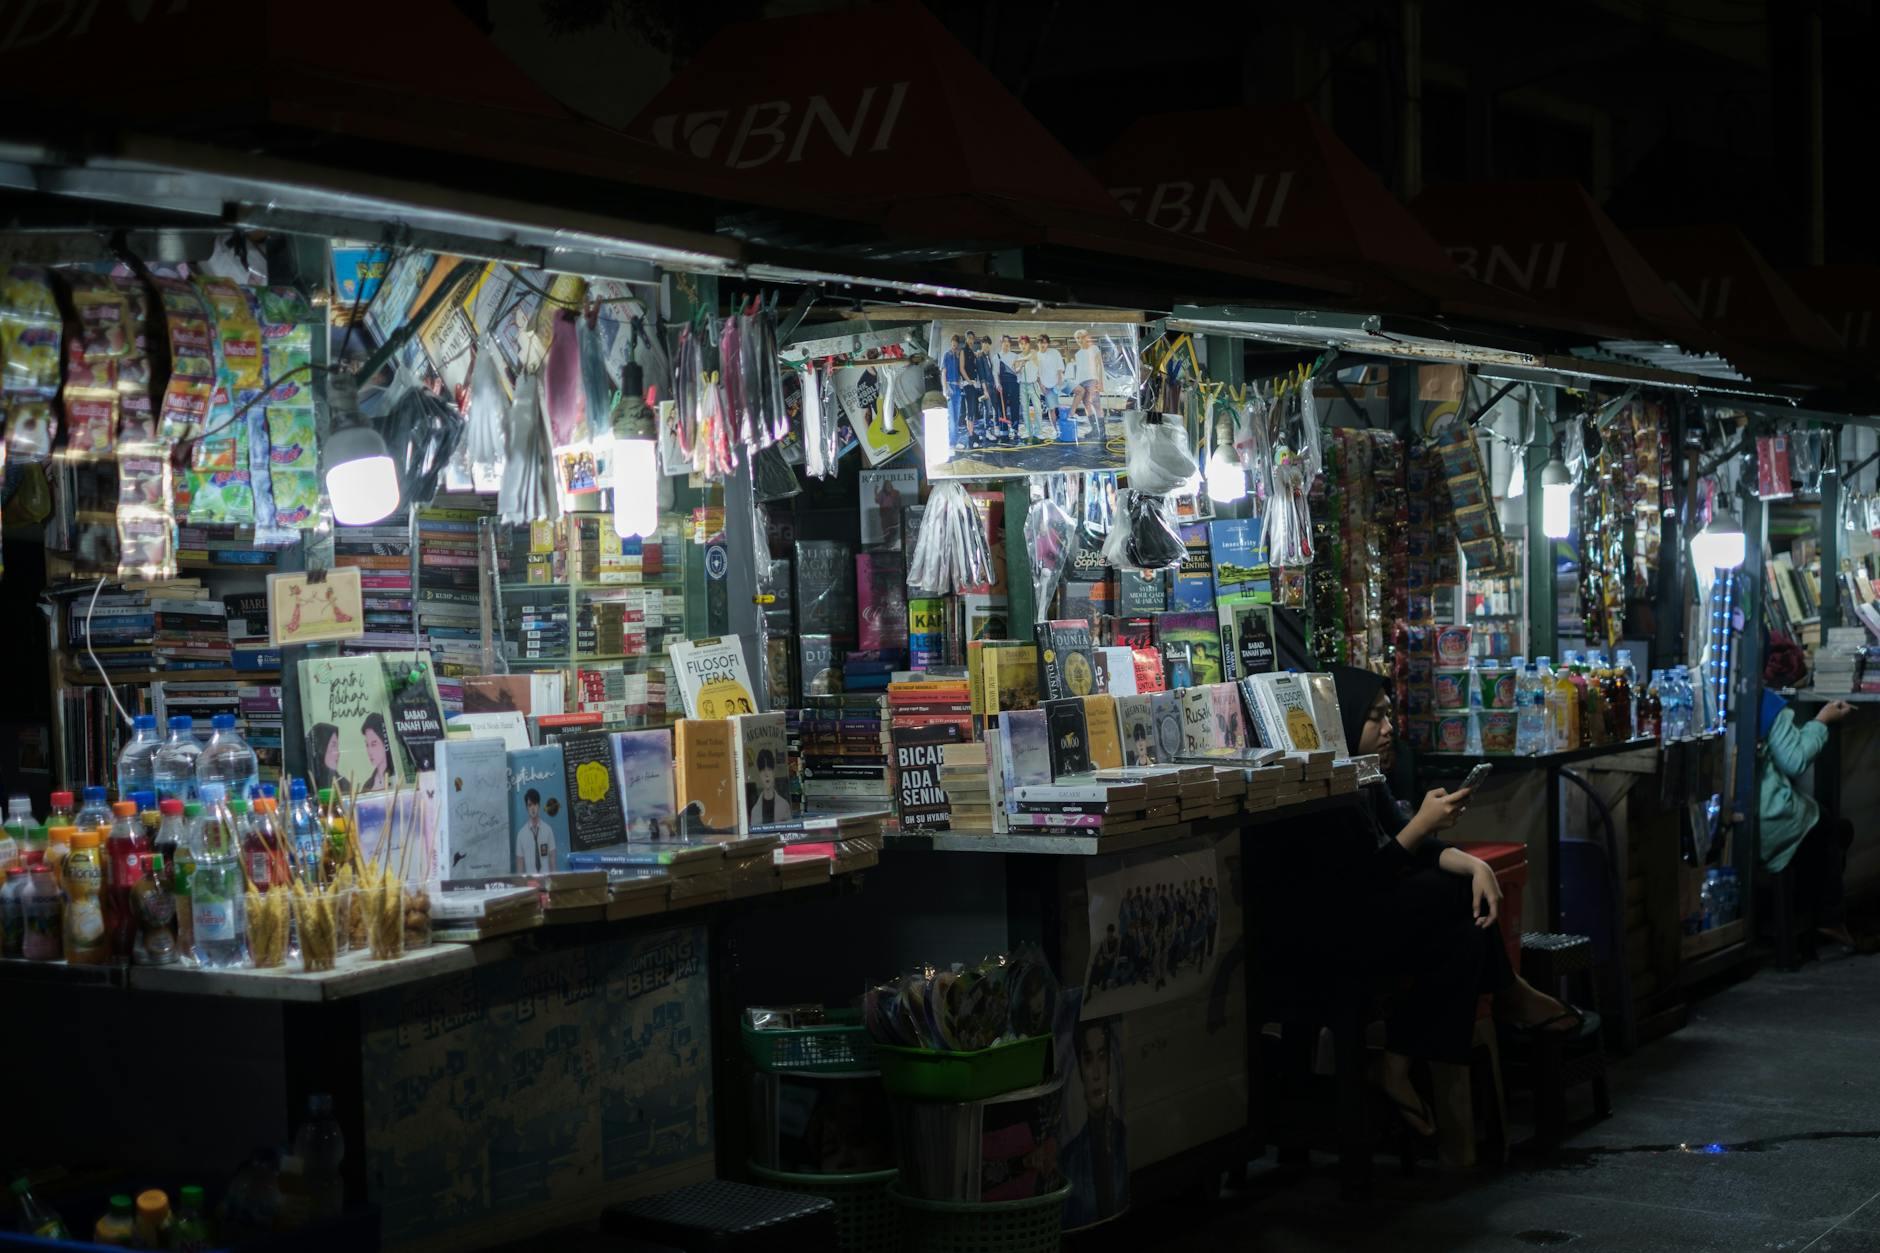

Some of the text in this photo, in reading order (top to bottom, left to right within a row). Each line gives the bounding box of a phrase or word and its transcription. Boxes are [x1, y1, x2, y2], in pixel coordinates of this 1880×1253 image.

[724, 81, 911, 170] BNI
[1145, 170, 1297, 235] BNI
[861, 472, 916, 484] REPUBLIK
[1080, 549, 1101, 560] Duni
[1074, 556, 1107, 571] Sophie
[1056, 634, 1089, 646] DUNIA
[1247, 641, 1265, 650] BABAD
[805, 650, 844, 662] DUNI
[686, 654, 740, 675] FILOSOFI
[698, 669, 736, 687] TERAS
[1048, 664, 1059, 700] DUNIA
[404, 710, 428, 720] BABAD
[395, 720, 440, 732] TANAH JAWA
[899, 745, 944, 767] BICAR
[506, 766, 556, 792] Septihan
[902, 771, 932, 789] ADA
[903, 787, 945, 806] SENIN
[905, 812, 949, 825] OH SU HYANG
